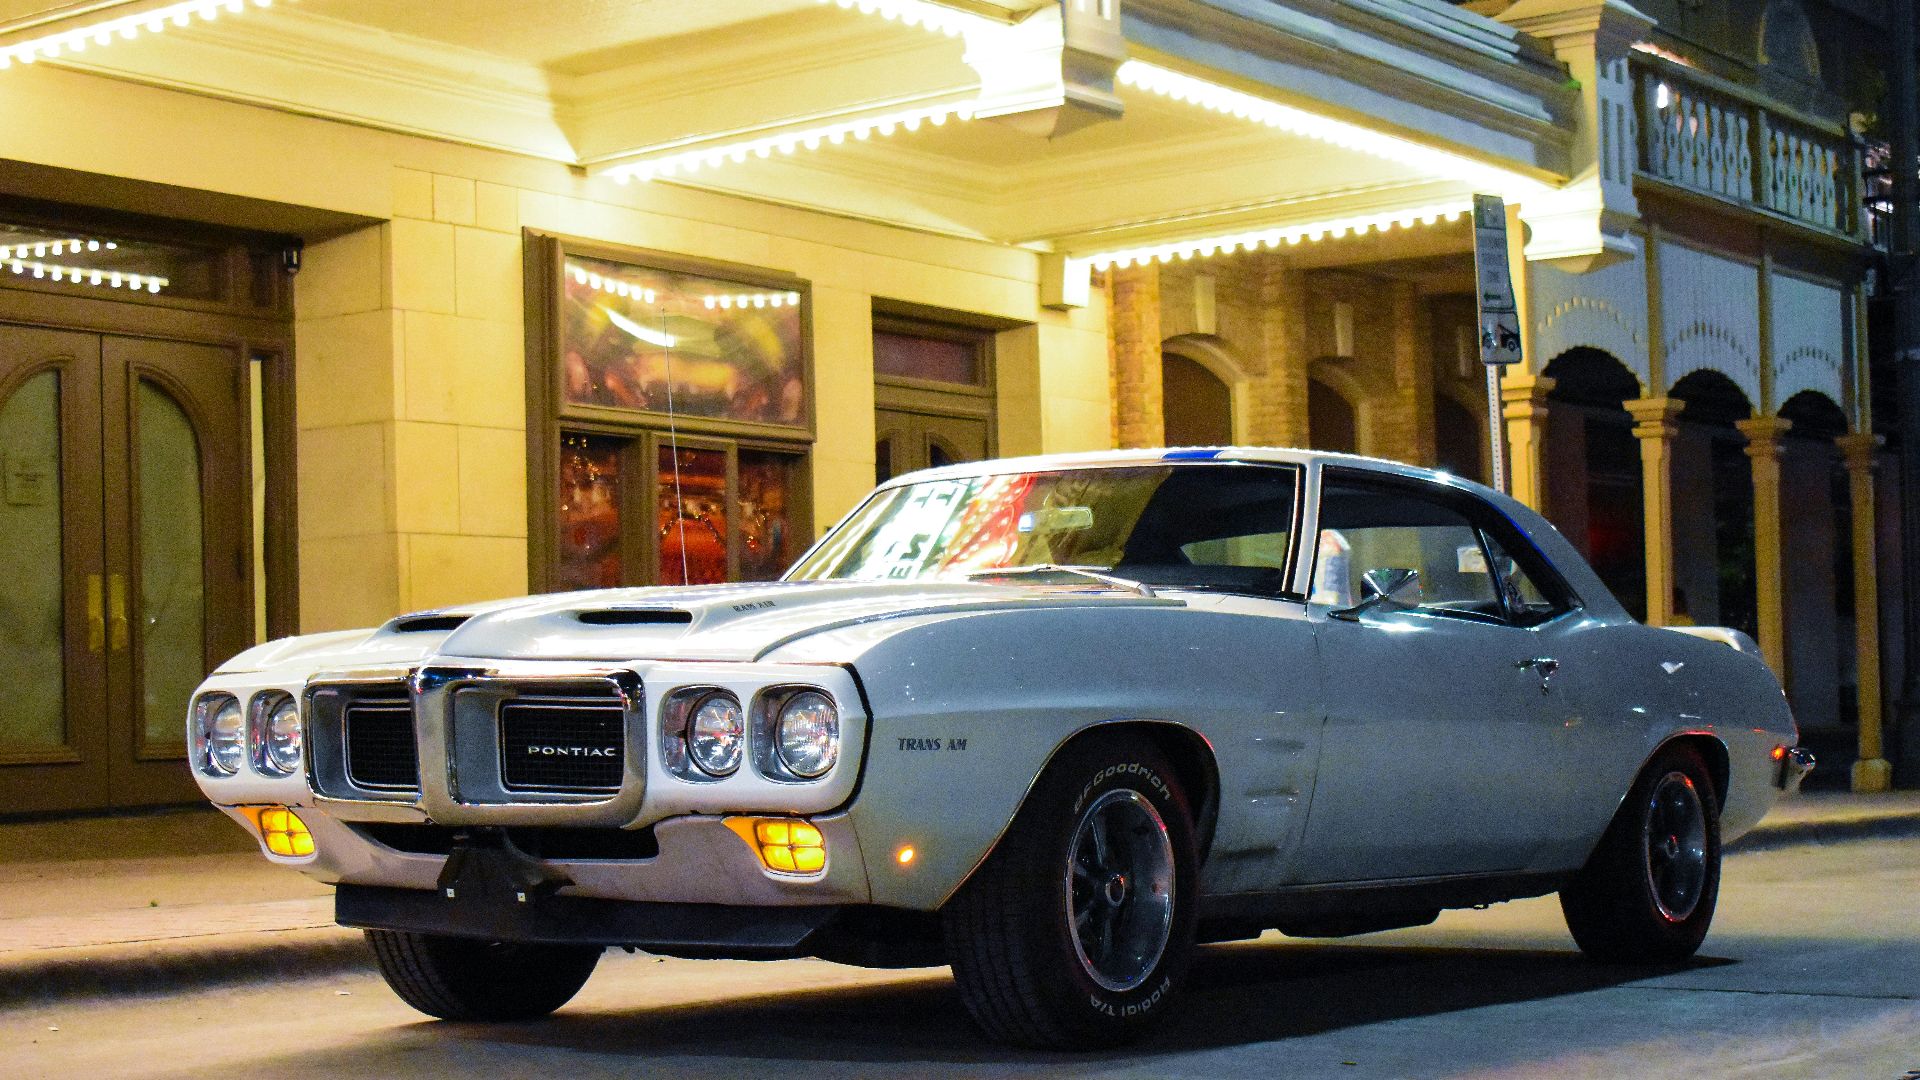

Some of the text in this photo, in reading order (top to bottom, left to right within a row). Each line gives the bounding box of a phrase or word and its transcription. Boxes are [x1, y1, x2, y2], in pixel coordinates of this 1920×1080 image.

[733, 600, 776, 612] RAM AIR
[898, 738, 968, 751] TRANS AM
[528, 746, 617, 757] PONTIAC
[1090, 976, 1170, 1017] Radial T/A
